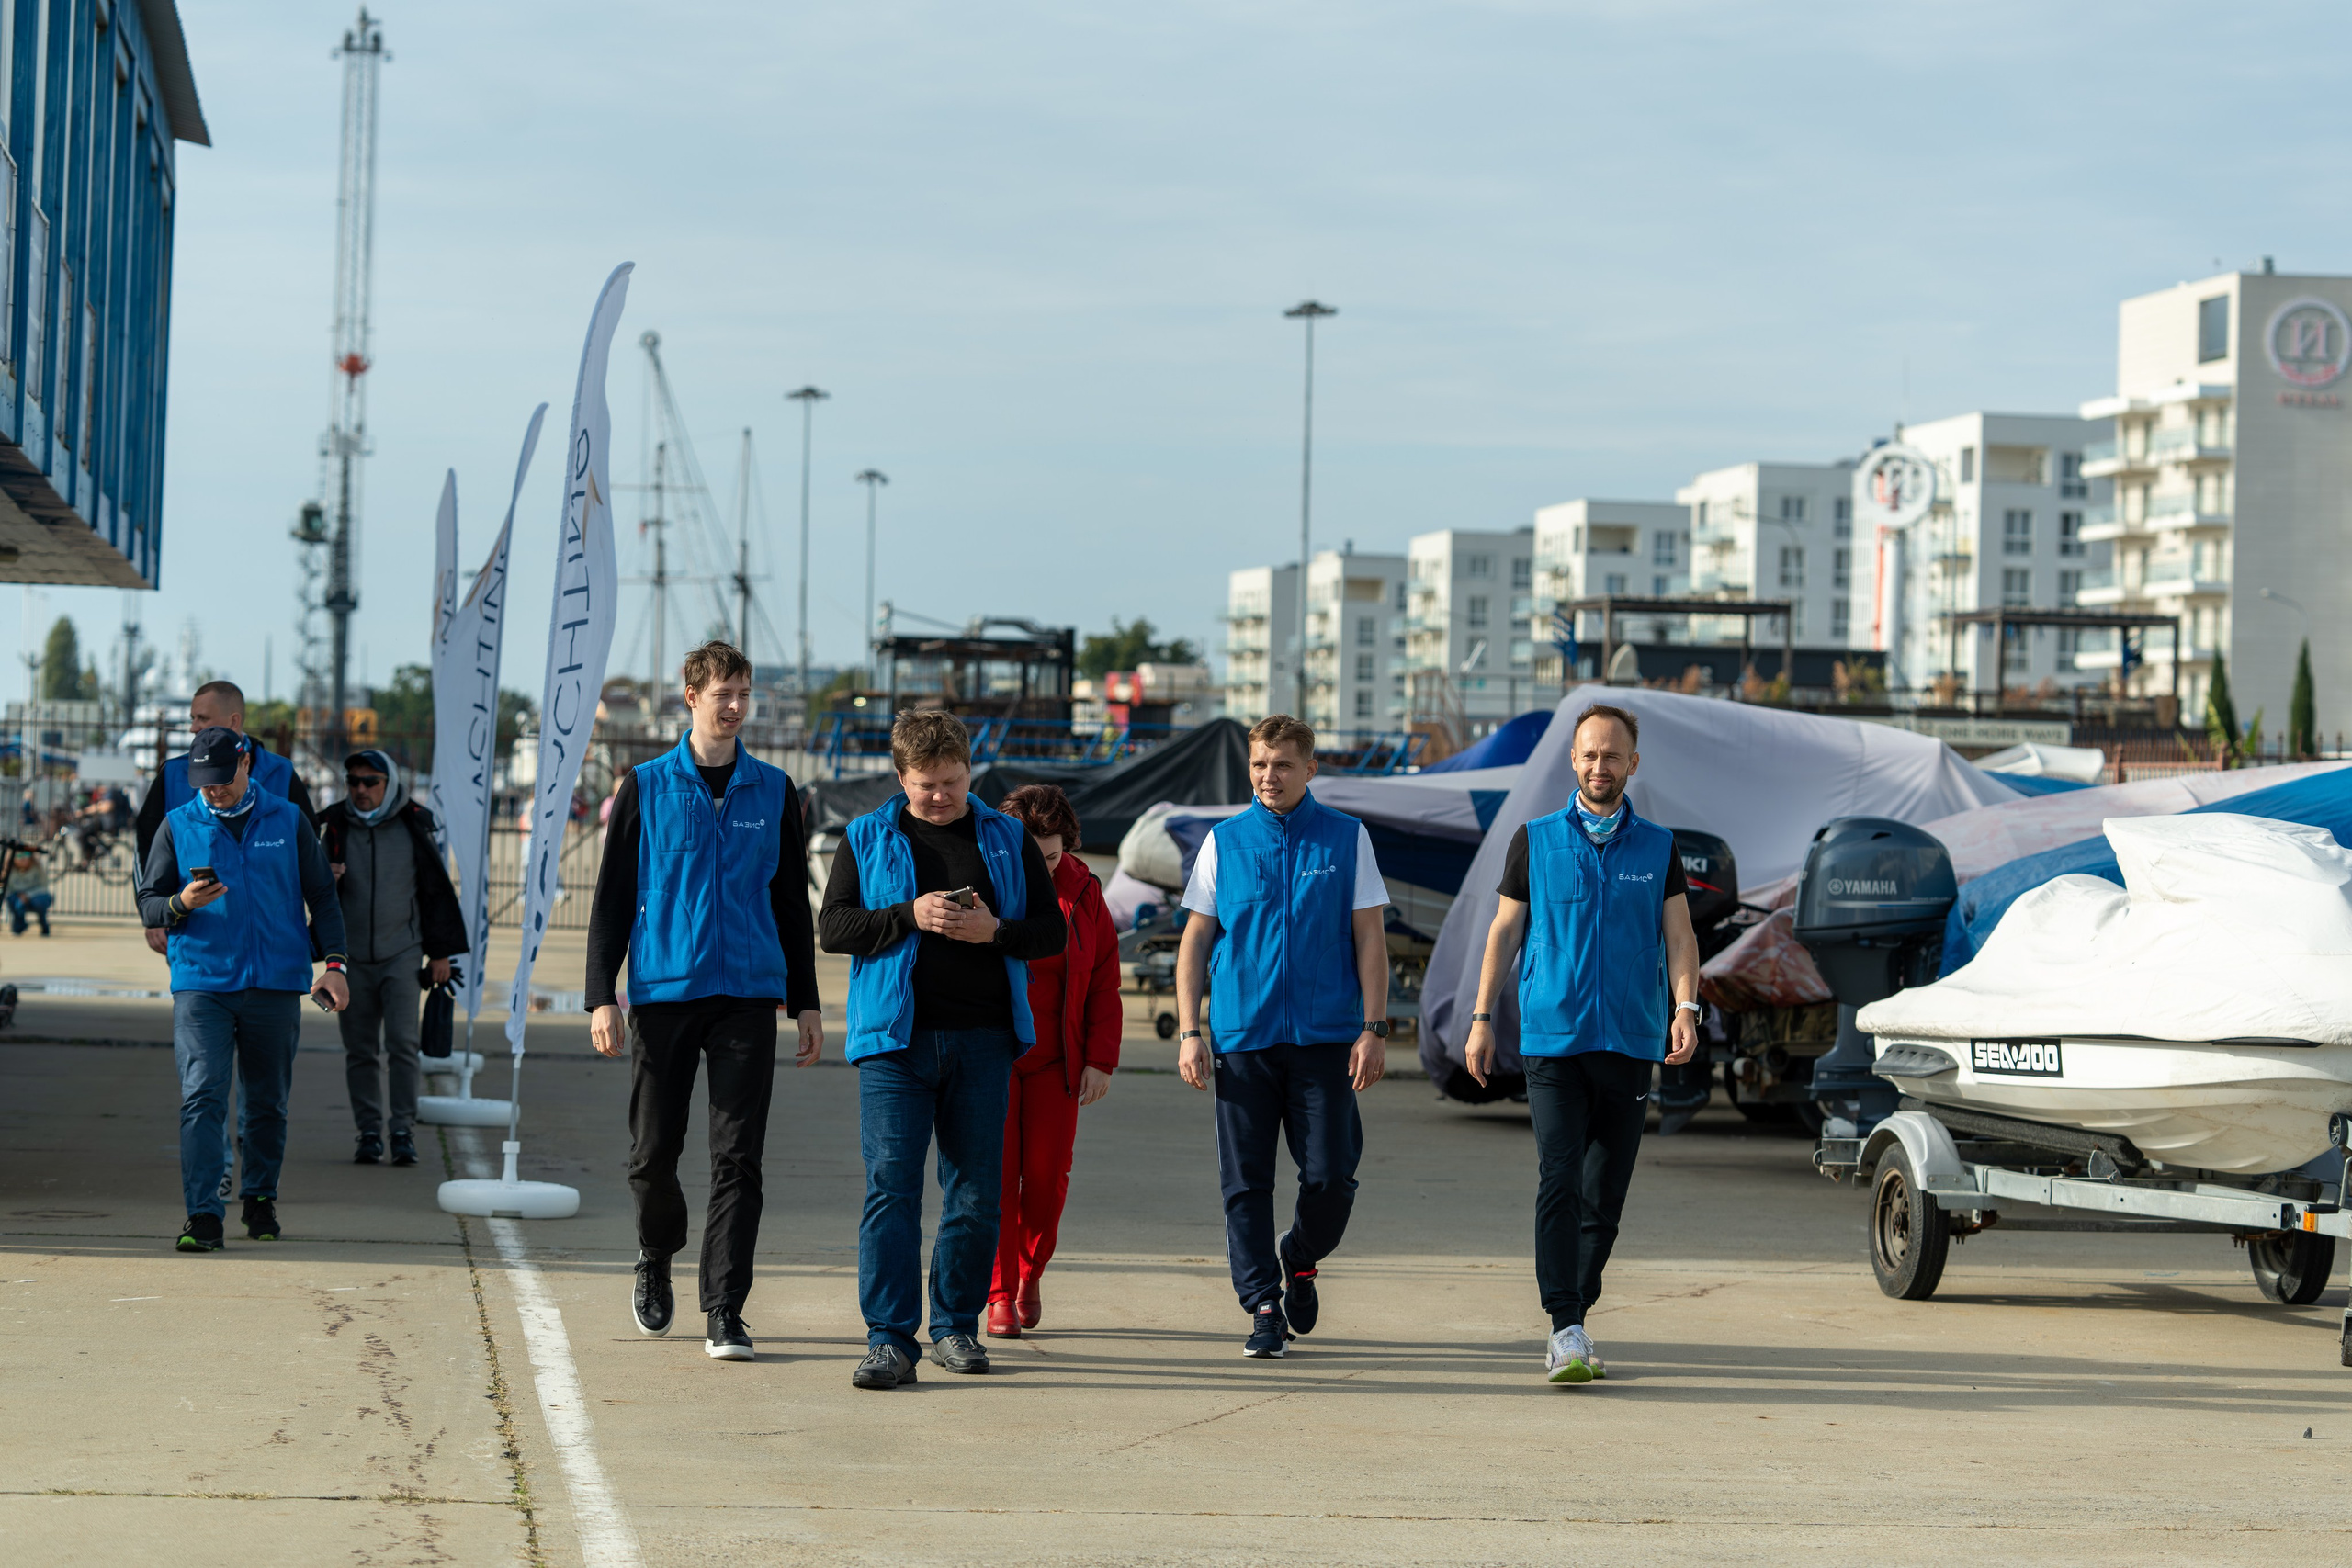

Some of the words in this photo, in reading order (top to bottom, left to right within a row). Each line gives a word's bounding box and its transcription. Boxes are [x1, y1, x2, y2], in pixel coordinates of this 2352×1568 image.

[732, 820, 761, 829] БАЗИС
[1301, 869, 1330, 877] БАЗИС
[1618, 874, 1647, 882] БАЗИС
[1843, 879, 1897, 896] YAMAHA
